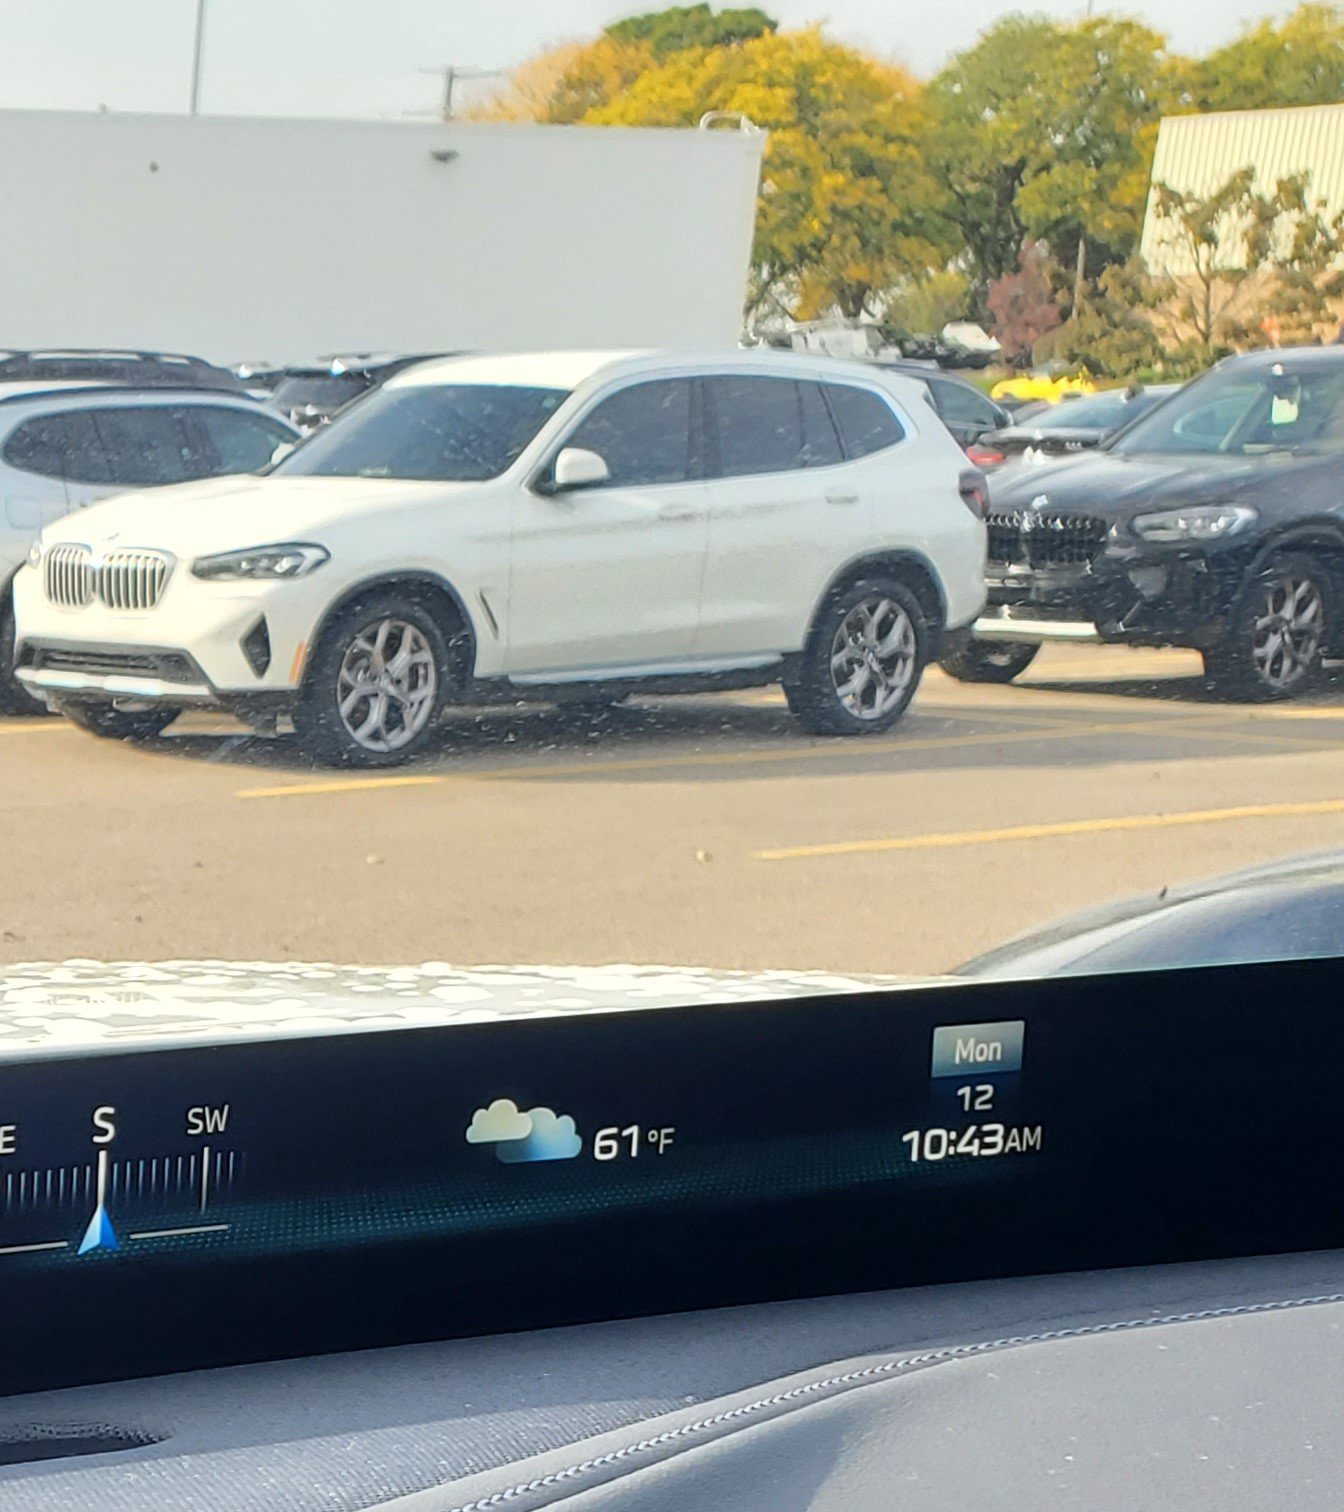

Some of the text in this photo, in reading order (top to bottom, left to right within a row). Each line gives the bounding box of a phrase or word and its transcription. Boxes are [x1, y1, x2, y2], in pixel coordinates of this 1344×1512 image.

[954, 1037, 1003, 1065] Mon
[956, 1084, 995, 1112] 12
[91, 1105, 116, 1144] S
[186, 1104, 230, 1136] SW
